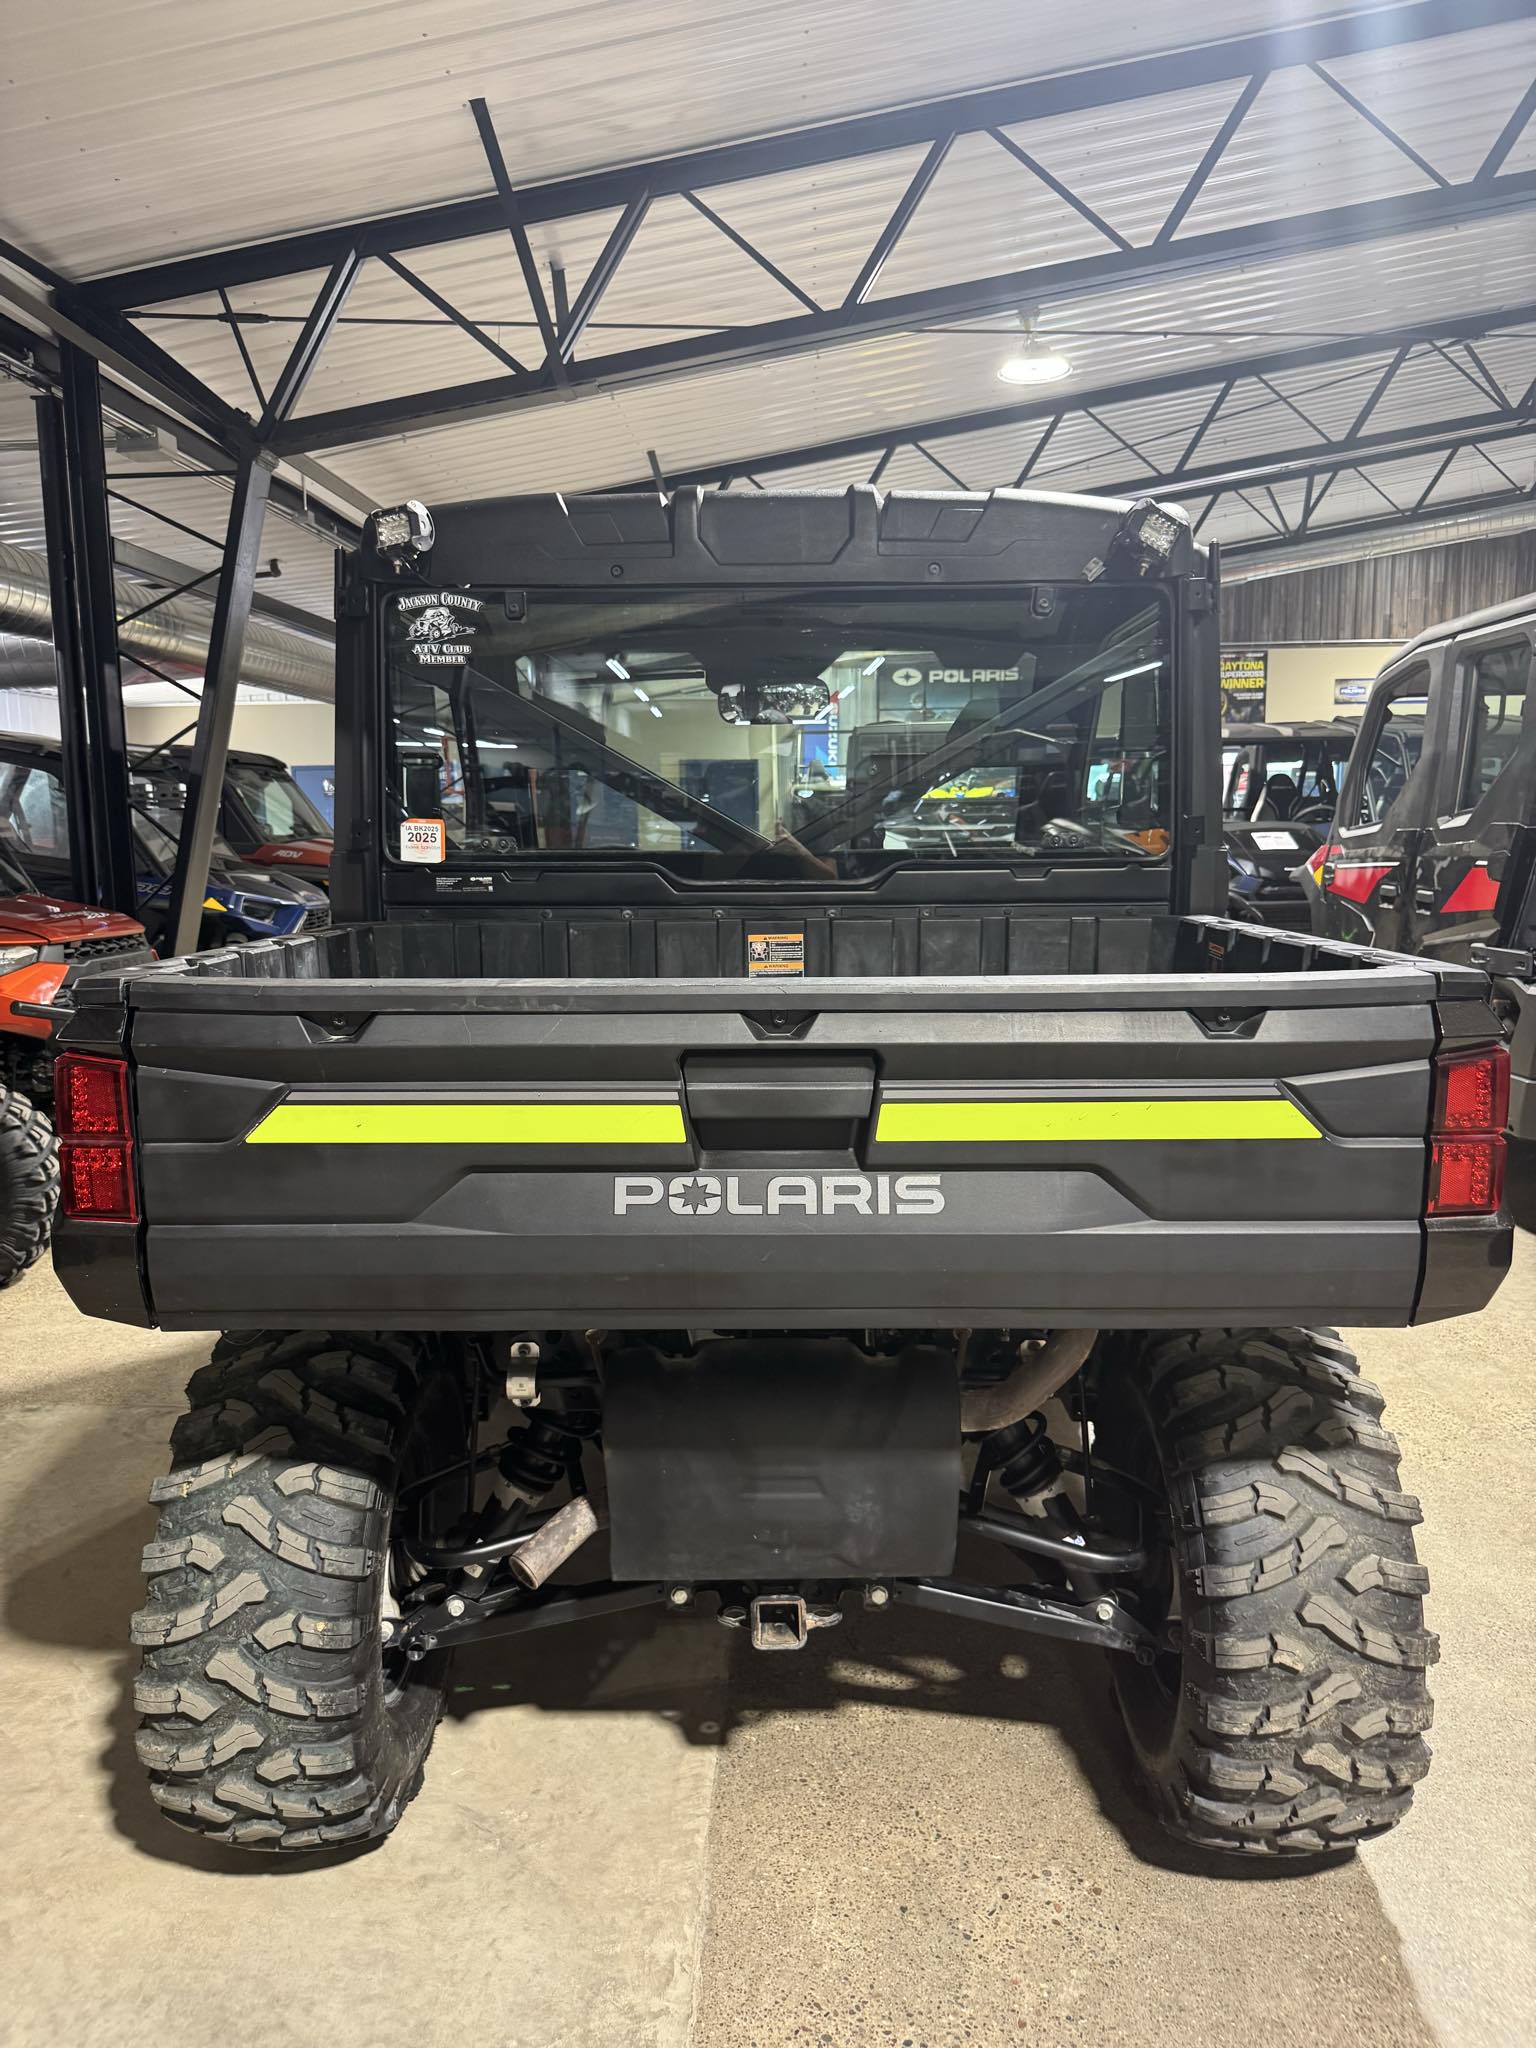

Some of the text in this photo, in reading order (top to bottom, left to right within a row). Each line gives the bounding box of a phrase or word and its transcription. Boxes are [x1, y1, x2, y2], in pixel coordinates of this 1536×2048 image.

[398, 592, 483, 612] JACKSON COUNTY
[412, 644, 472, 654] ATV CLUB
[419, 654, 466, 664] MEMBER
[929, 667, 1019, 683] POLARIS
[408, 832, 437, 843] 2025
[613, 1175, 945, 1215] POLARIS
